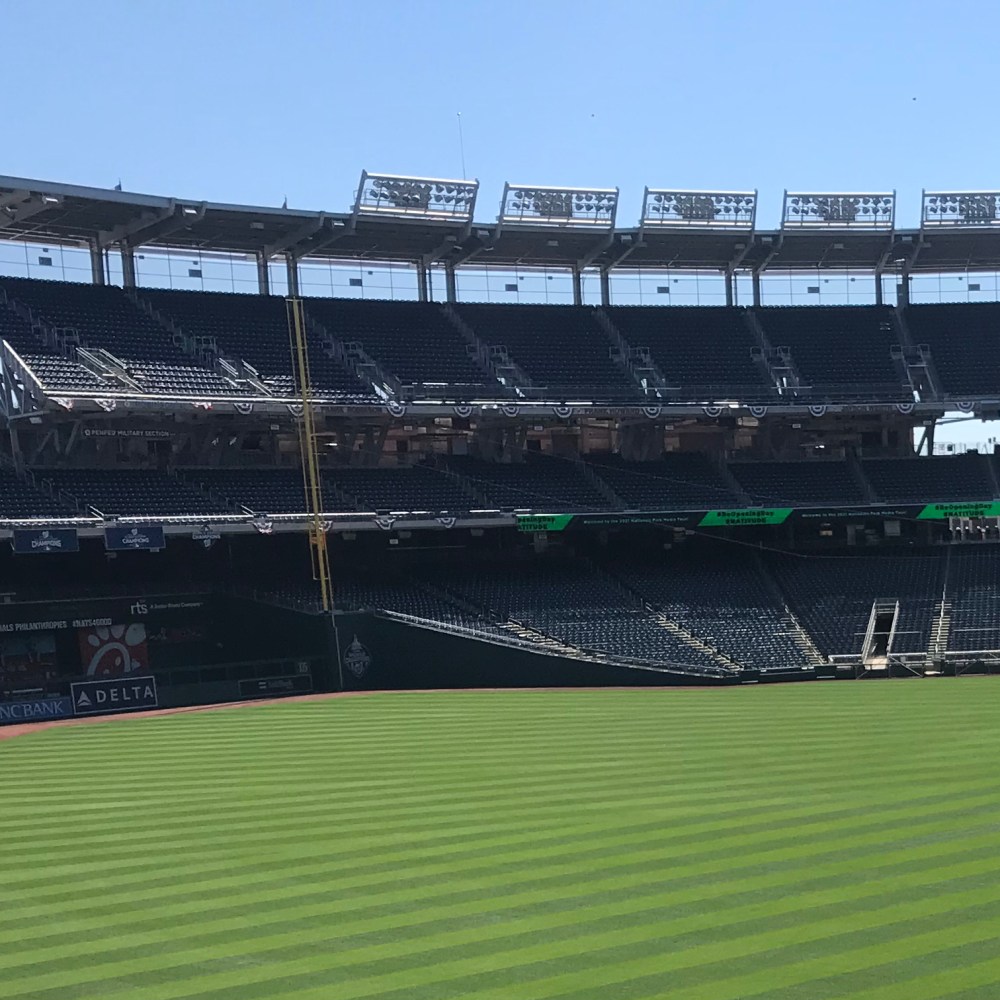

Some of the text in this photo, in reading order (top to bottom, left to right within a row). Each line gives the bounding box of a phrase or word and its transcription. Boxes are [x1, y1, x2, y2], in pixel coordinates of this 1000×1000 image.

[31, 538, 62, 549] CHAMPIONS
[121, 536, 150, 545] CHAMPIONS
[130, 601, 149, 615] rts
[14, 620, 68, 631] PHILANTHROPIES
[96, 685, 155, 704] DELTA
